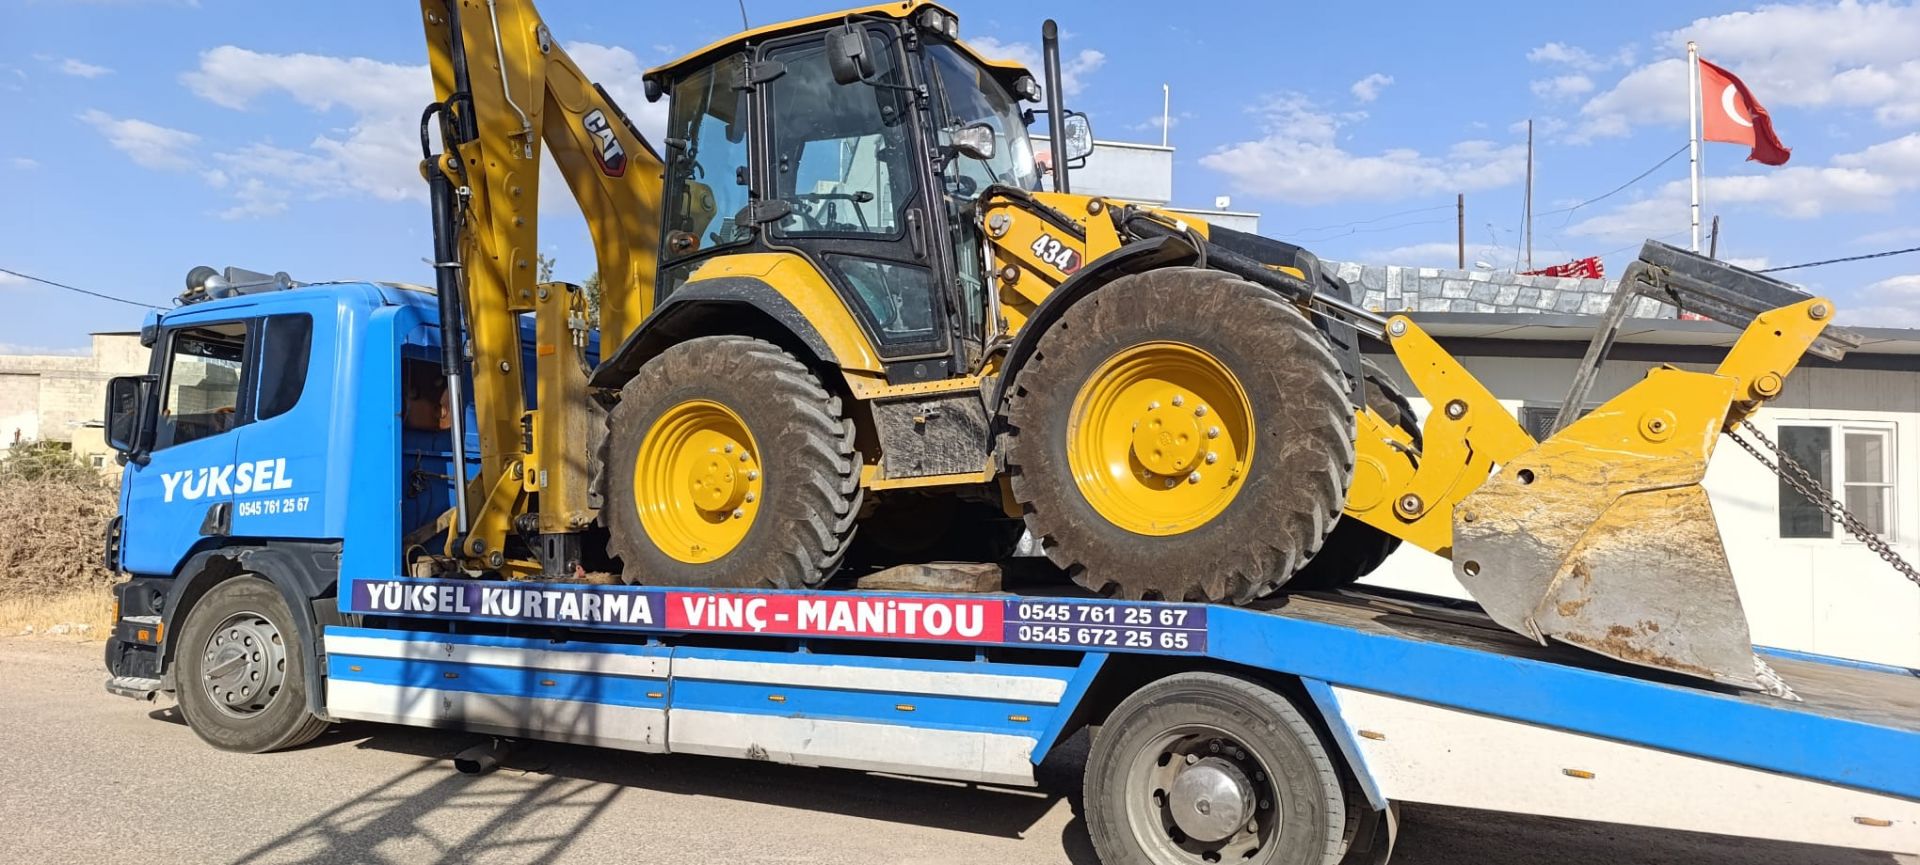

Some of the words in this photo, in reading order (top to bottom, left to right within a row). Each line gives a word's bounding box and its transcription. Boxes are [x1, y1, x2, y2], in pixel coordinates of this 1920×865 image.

[584, 109, 624, 162] CAT
[1031, 234, 1074, 271] 434
[239, 501, 262, 517] 0545
[264, 499, 280, 514] 761
[283, 498, 295, 513] 25
[297, 497, 309, 512] 67
[366, 582, 471, 613] YÜKSEL
[480, 588, 653, 625] KURTARMA
[1018, 604, 1071, 621] 0545
[1077, 606, 1115, 623] 761
[1124, 607, 1152, 625] 25
[1159, 609, 1188, 626] 67
[1018, 626, 1071, 643] 0545
[1077, 628, 1118, 646] 672
[1124, 630, 1152, 647] 25
[1159, 632, 1189, 649] 65
